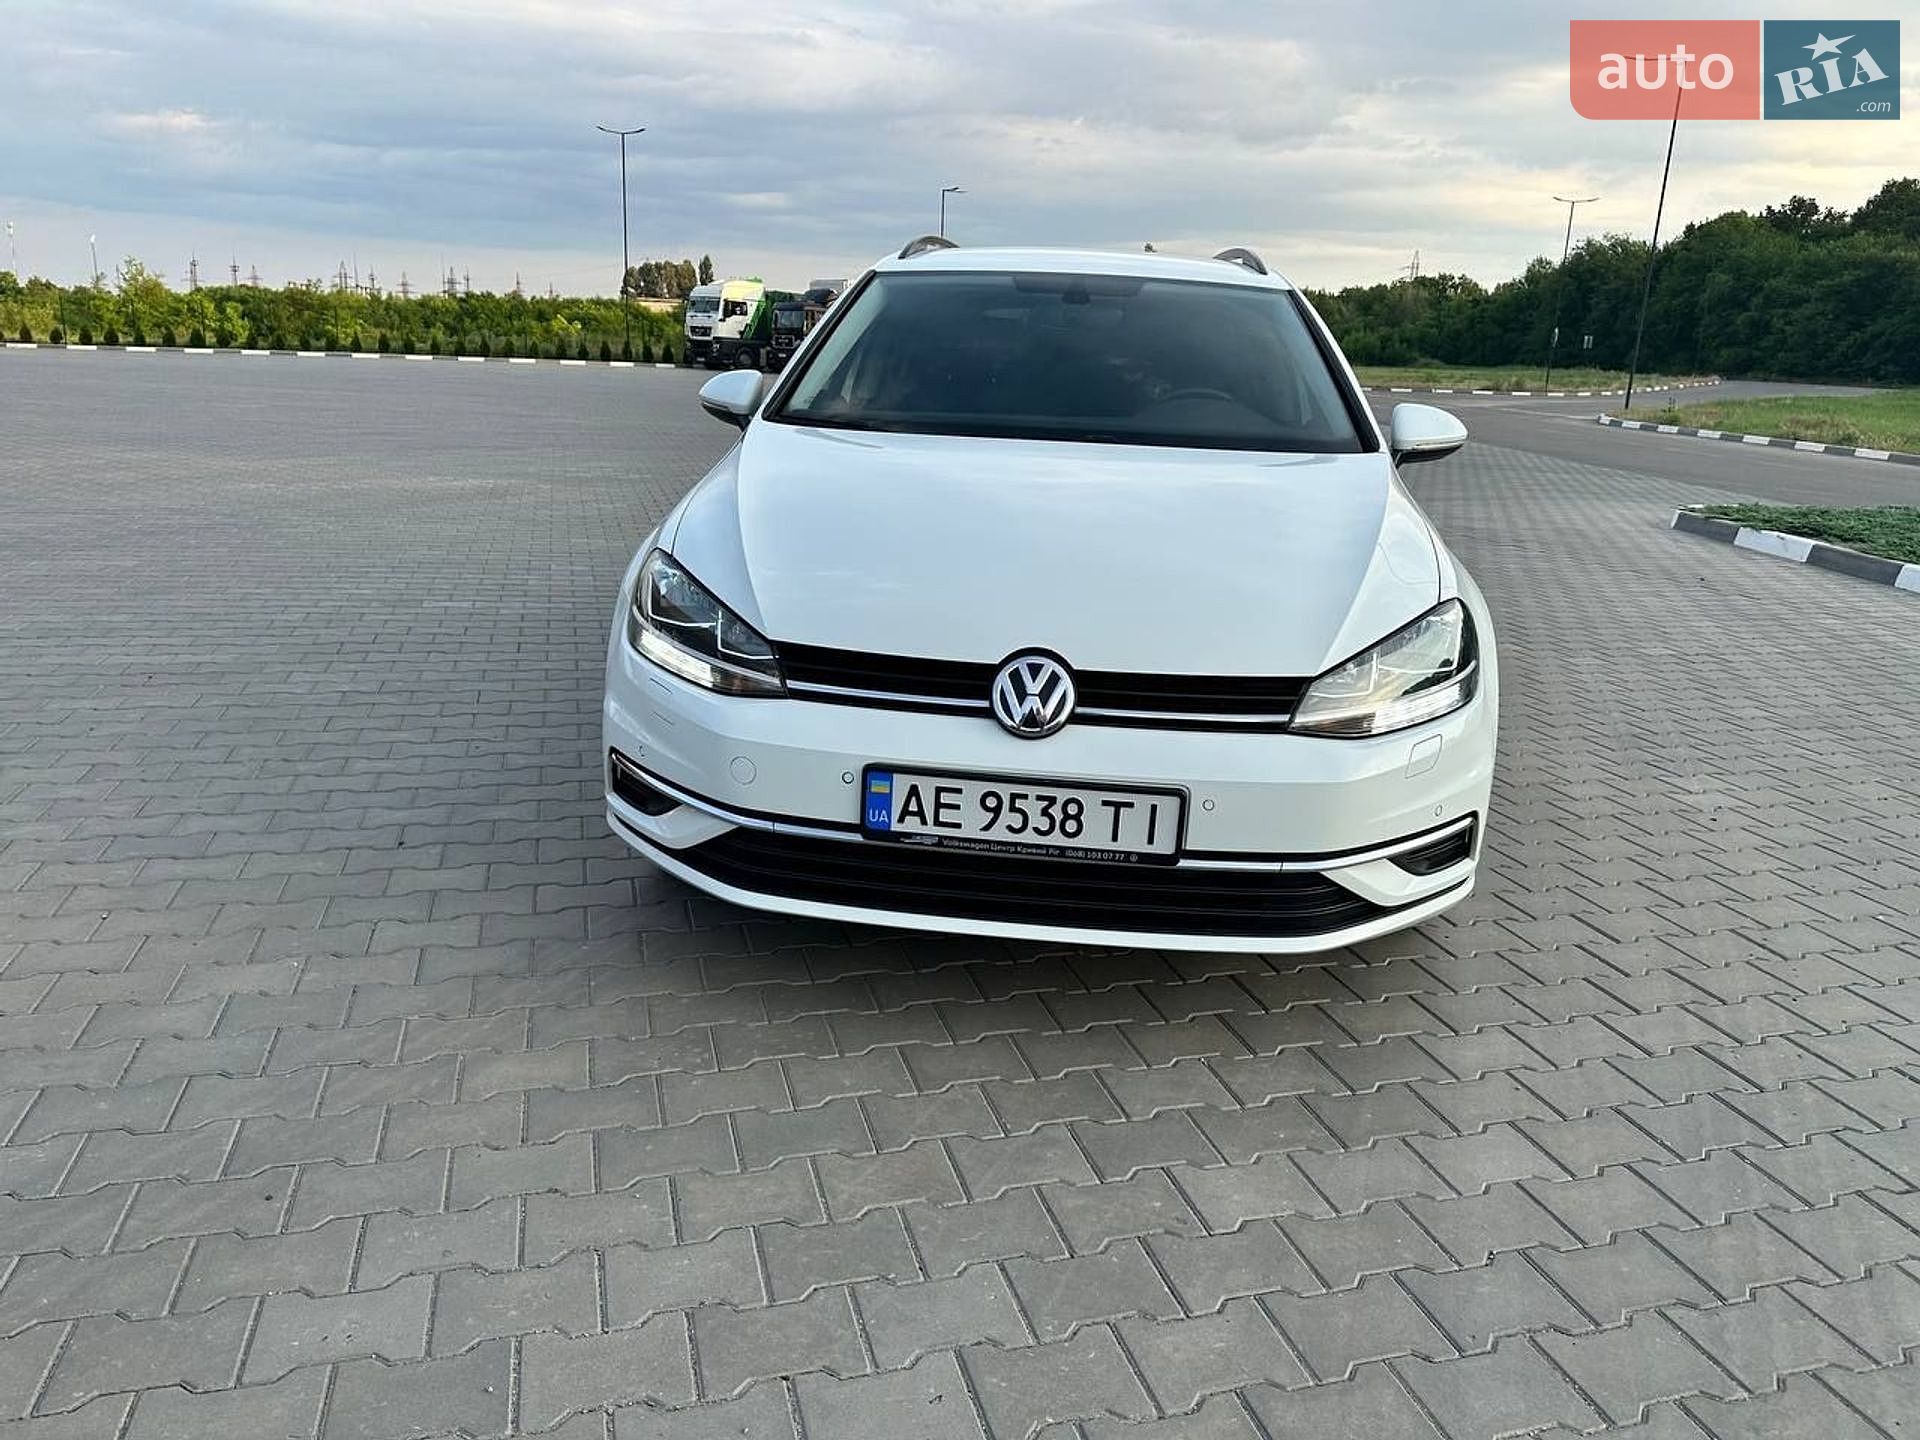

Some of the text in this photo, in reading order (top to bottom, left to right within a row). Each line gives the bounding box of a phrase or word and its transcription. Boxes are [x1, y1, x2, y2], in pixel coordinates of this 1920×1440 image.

[995, 658, 1072, 731] VW
[869, 809, 889, 823] UA
[897, 783, 1158, 846] AE 9538 TI
